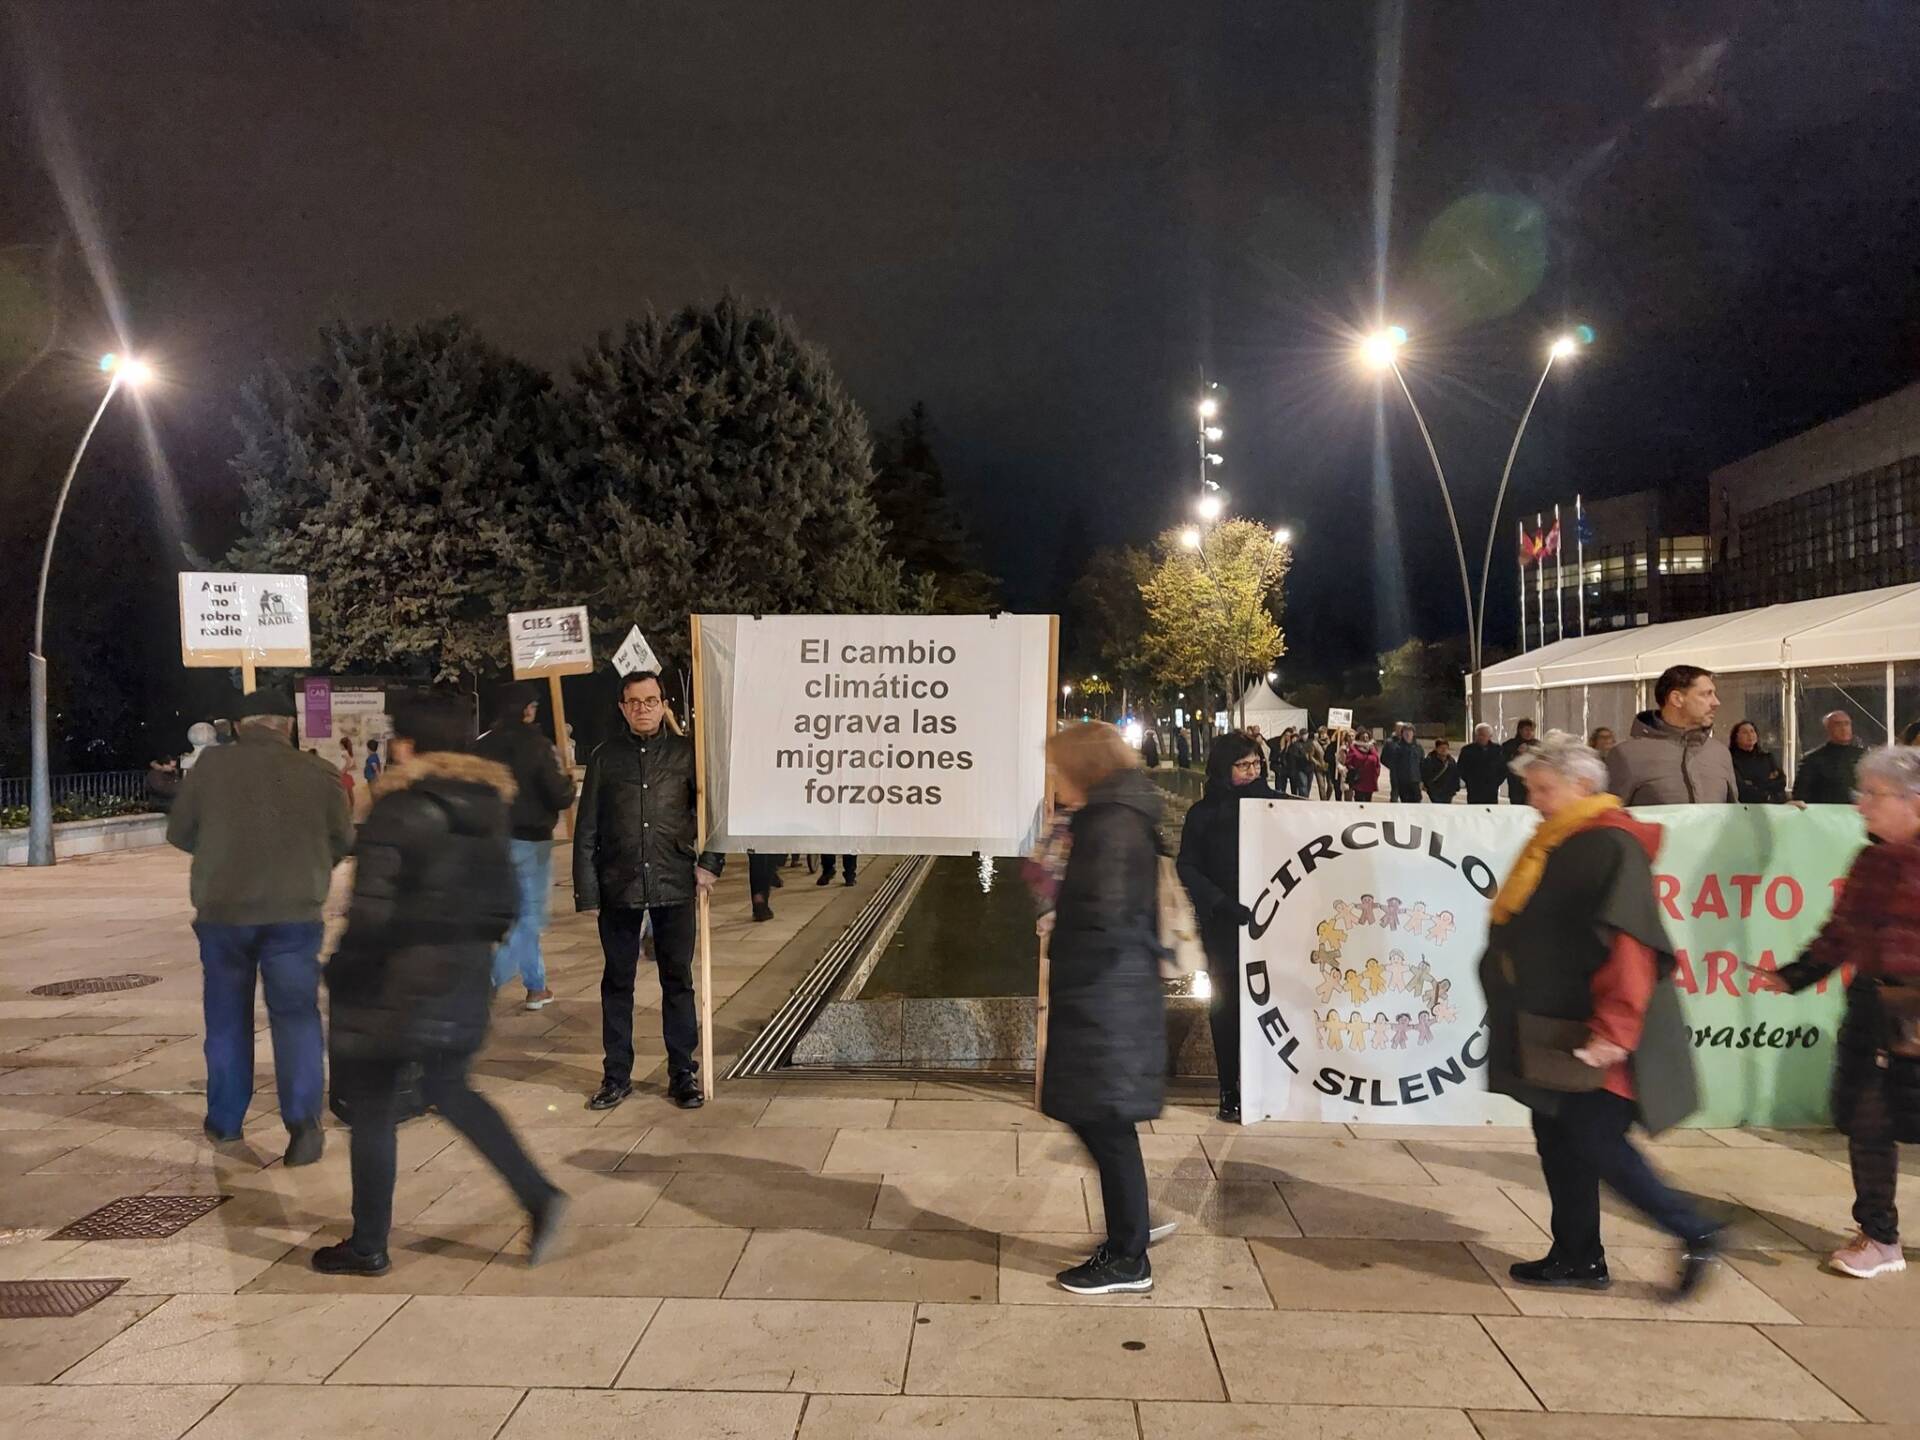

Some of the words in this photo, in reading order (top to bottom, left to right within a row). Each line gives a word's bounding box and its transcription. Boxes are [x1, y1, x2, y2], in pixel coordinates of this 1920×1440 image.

[201, 581, 237, 593] Aquí
[211, 598, 229, 607] no
[200, 611, 241, 621] sobra
[258, 615, 295, 627] NADIE
[522, 616, 553, 631] CIES
[200, 626, 242, 636] nadie
[800, 639, 829, 663] El
[841, 639, 956, 664] cambio
[804, 673, 949, 699] climático
[793, 713, 900, 740] agrava
[912, 708, 957, 734] las
[776, 743, 974, 776] migraciones
[804, 778, 942, 805] forzosas
[1248, 820, 1498, 941] CIRCULO
[1652, 873, 1805, 921] RATO
[1245, 960, 1300, 1075] DEL
[1687, 1021, 1820, 1049] rastero
